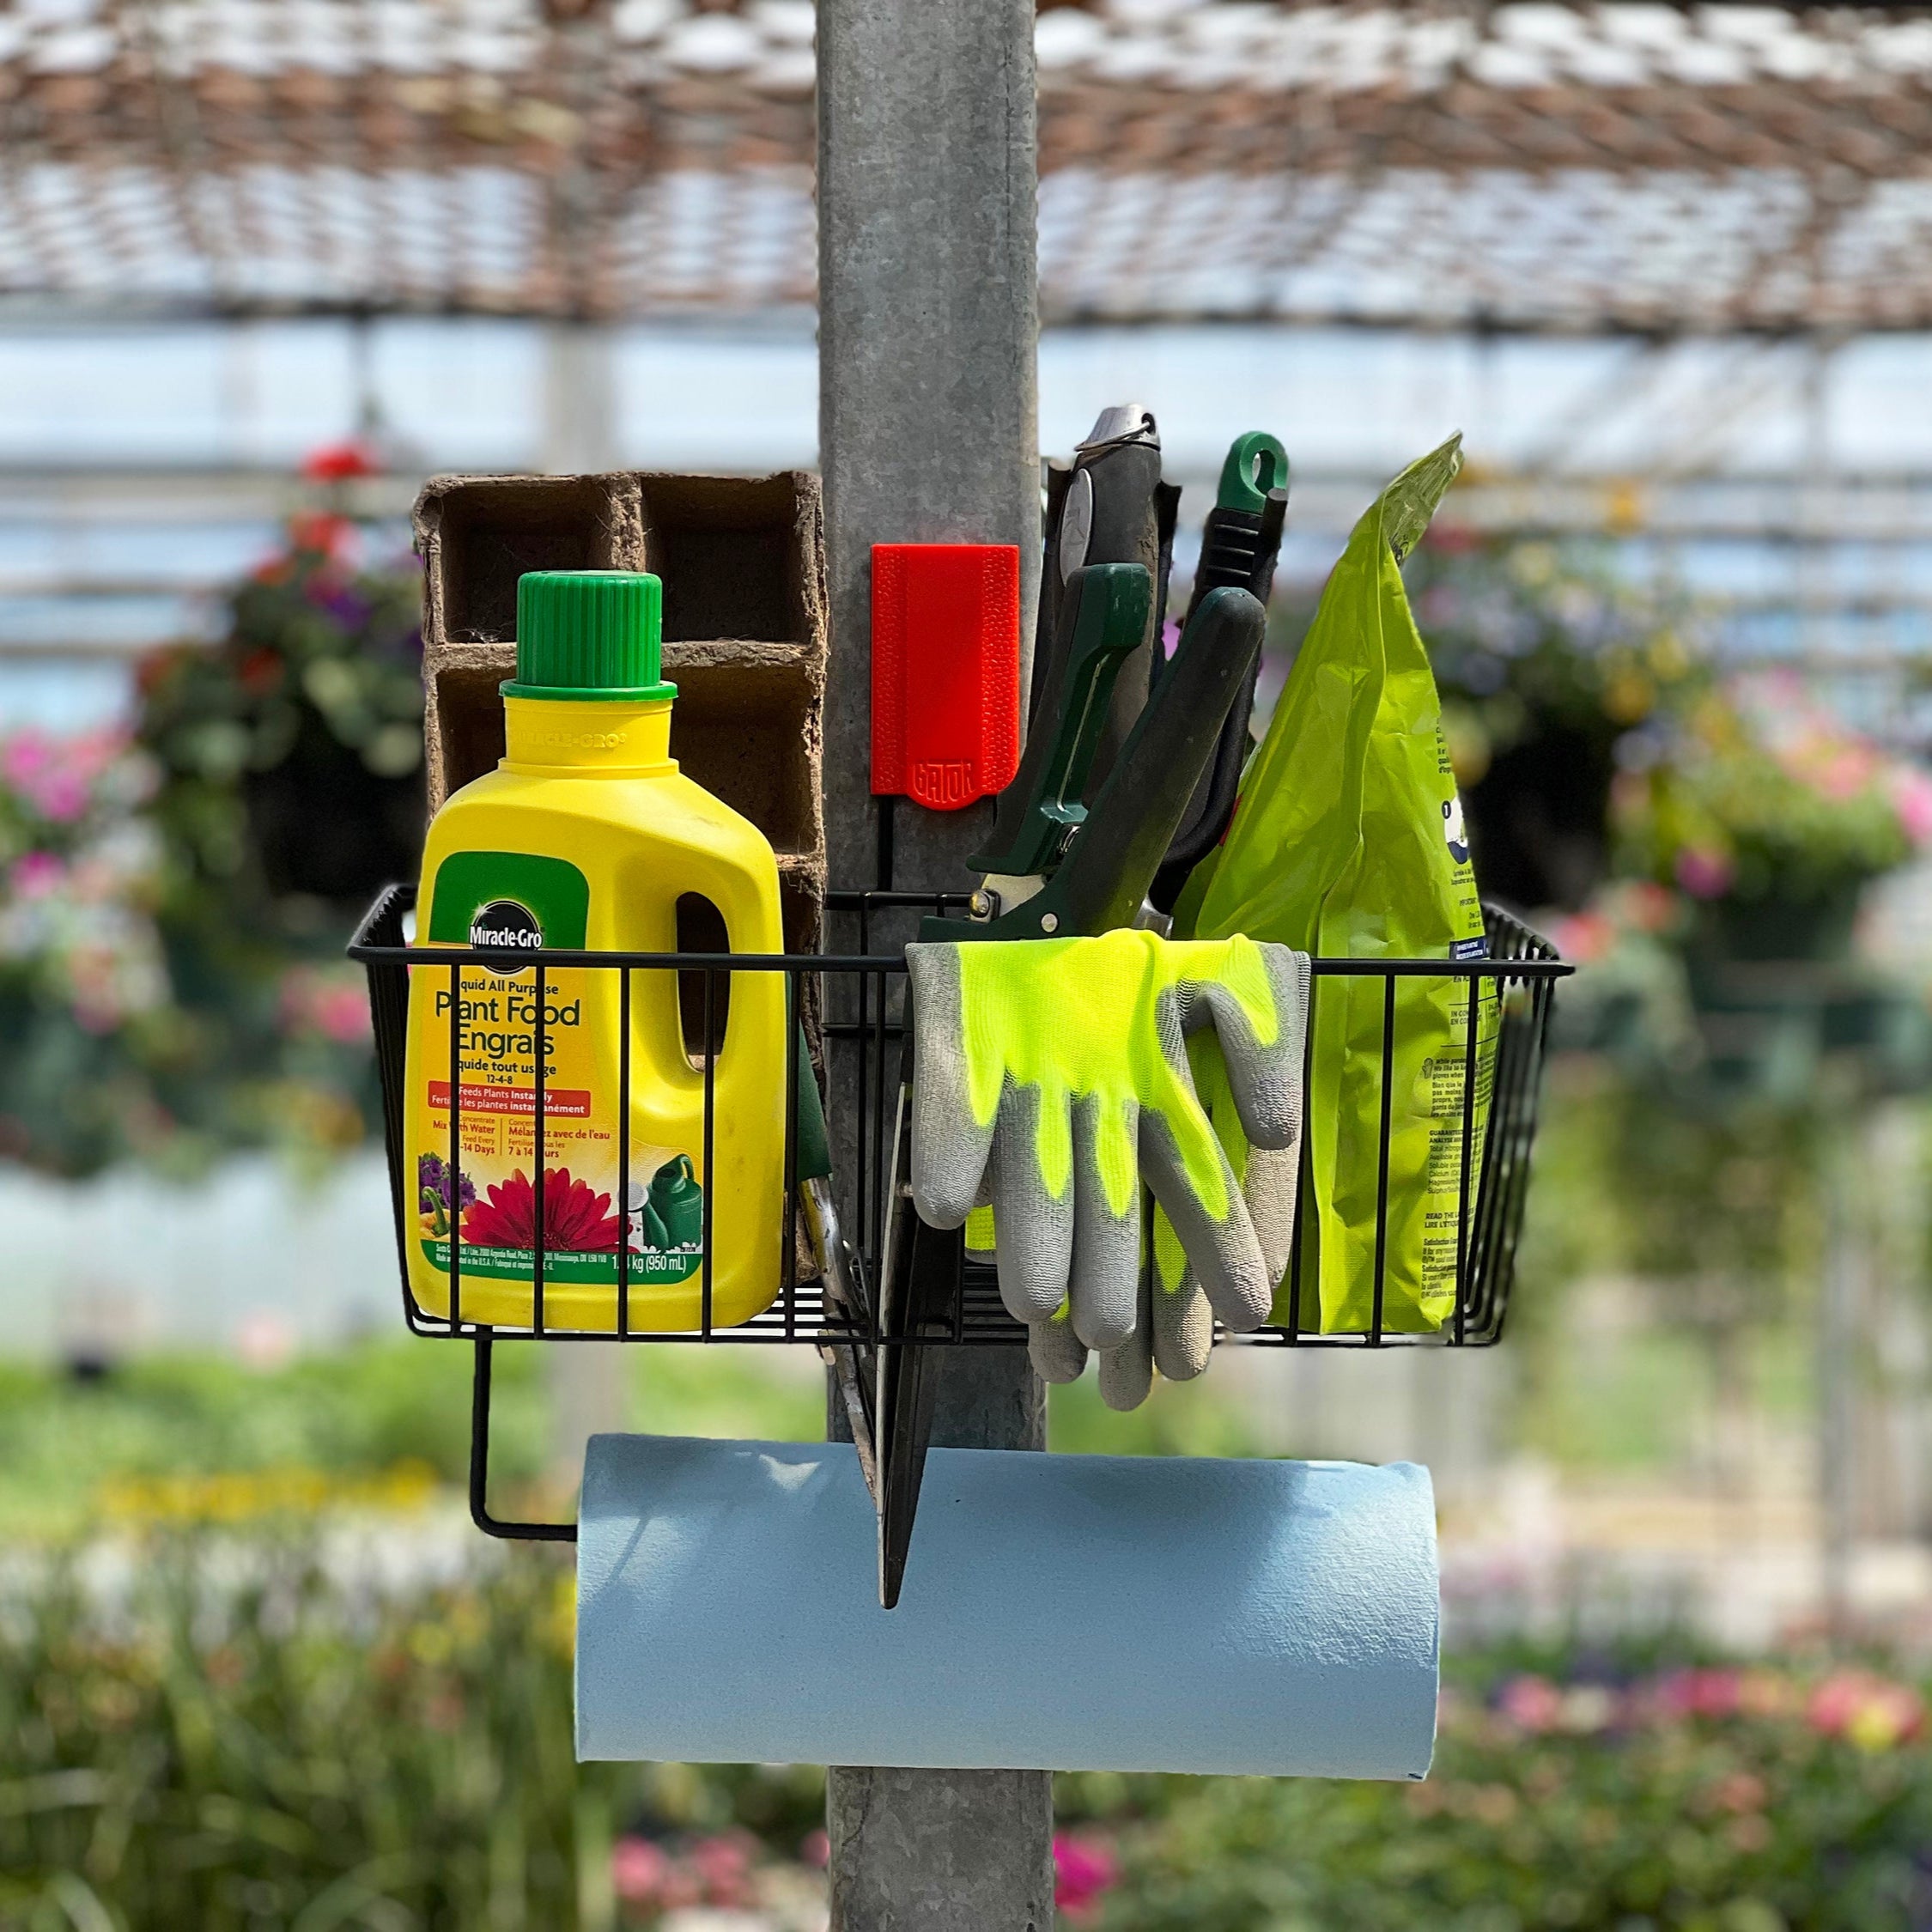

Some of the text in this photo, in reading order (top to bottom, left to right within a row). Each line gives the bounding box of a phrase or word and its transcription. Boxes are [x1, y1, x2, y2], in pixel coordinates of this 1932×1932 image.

[470, 926, 543, 948] Miracle-Gro
[455, 980, 559, 996] quid All Purpse
[435, 991, 580, 1026] Pant Food
[455, 1058, 556, 1078] quide tout usge
[487, 1074, 513, 1084] 12-4-8
[459, 1086, 553, 1103] Feeds Plants Instaly
[432, 1096, 585, 1114] Fertie les plantes instaanément
[433, 1120, 447, 1130] Mix
[470, 1124, 495, 1134] Water
[509, 1119, 536, 1127] Concen
[509, 1127, 551, 1138] Mélanez
[575, 1129, 587, 1139] de
[589, 1129, 610, 1139] l'eau
[478, 1136, 495, 1145] Every
[508, 1139, 535, 1147] Fertilise
[458, 1142, 495, 1156] -14 Days
[508, 1146, 513, 1155] 7
[516, 1145, 521, 1156] à
[524, 1147, 533, 1156] 14
[632, 1255, 644, 1273] kg
[646, 1255, 666, 1273] (950
[669, 1255, 687, 1273] mL)
